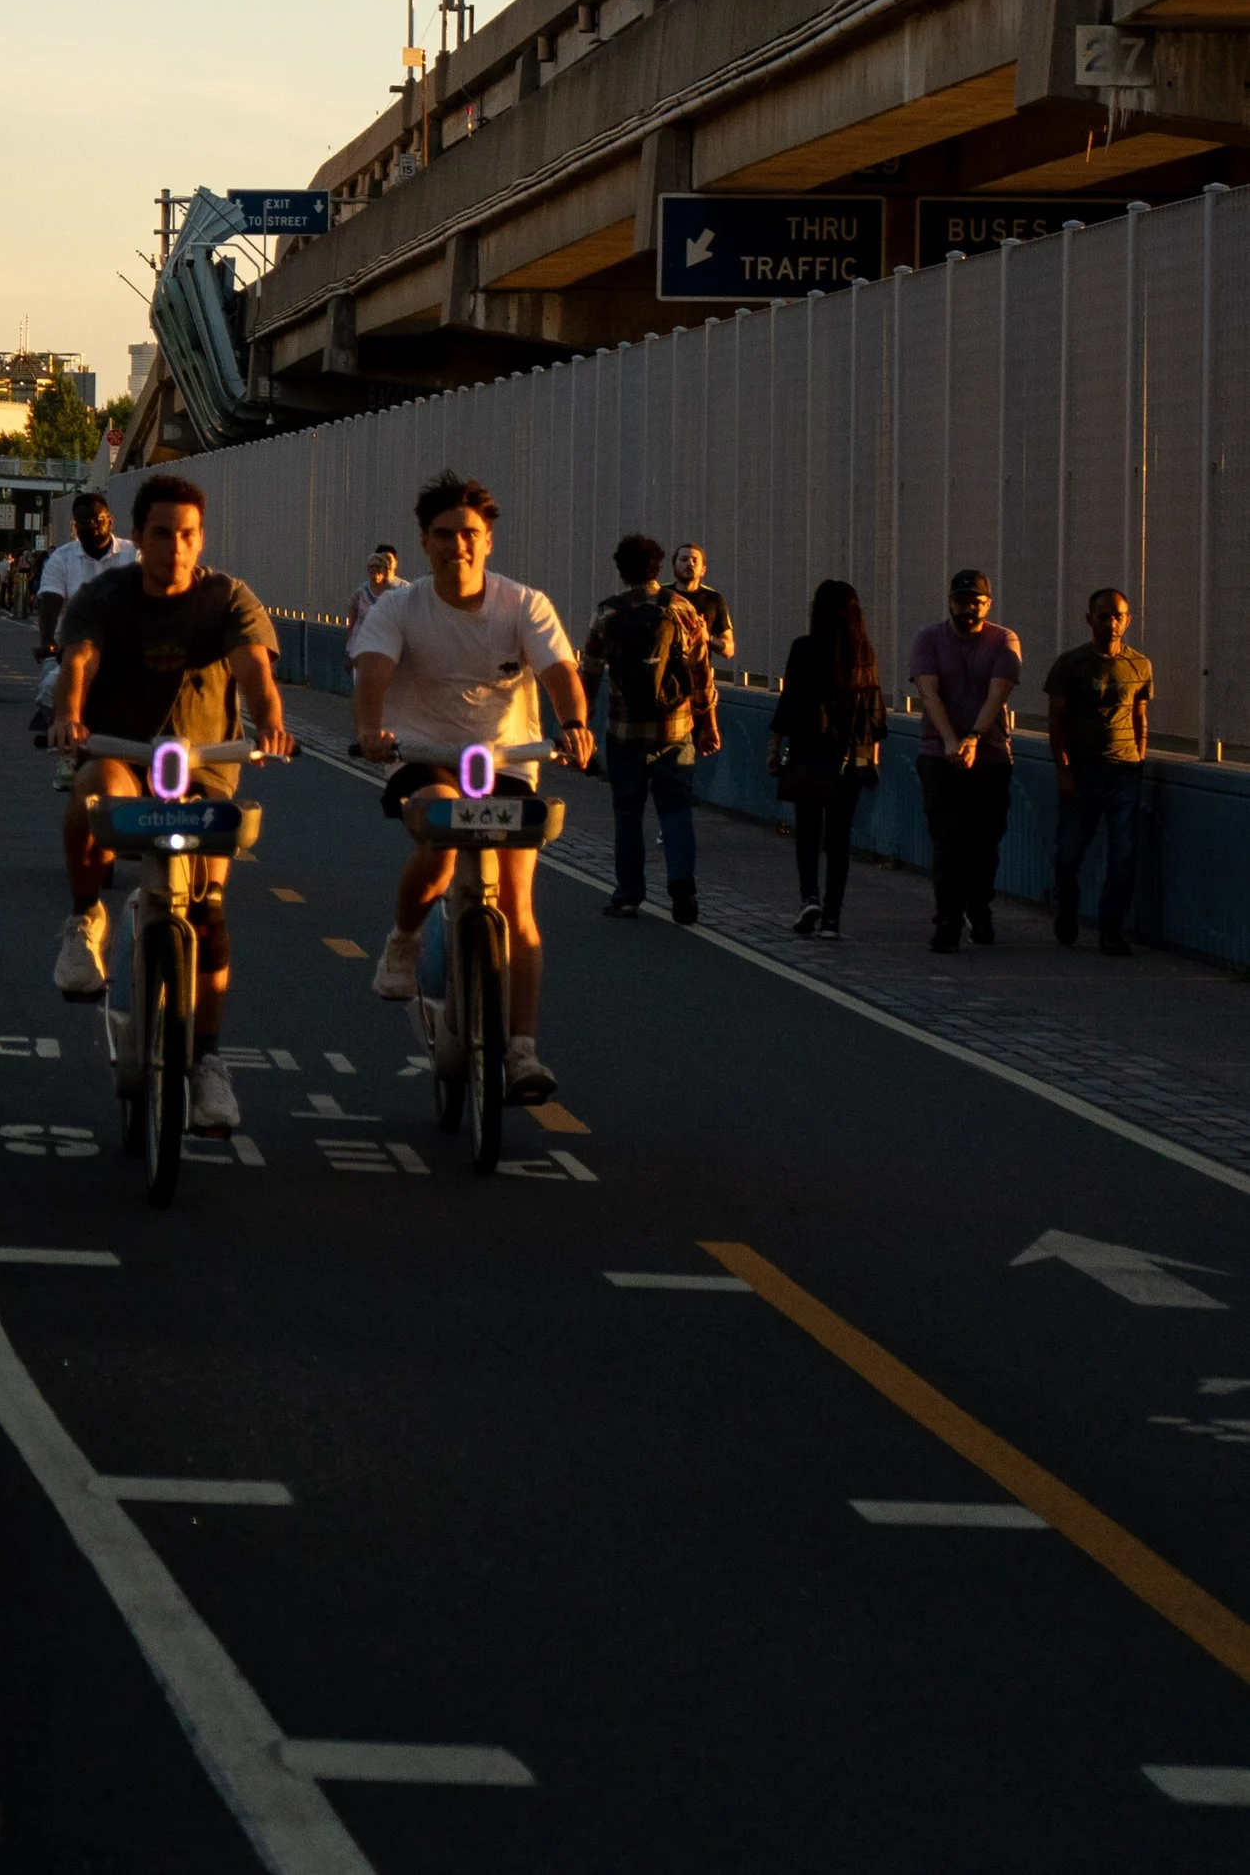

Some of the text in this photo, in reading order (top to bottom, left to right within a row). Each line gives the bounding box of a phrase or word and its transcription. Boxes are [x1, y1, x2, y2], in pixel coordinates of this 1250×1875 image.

[1085, 36, 1146, 74] 27
[403, 166, 413, 175] 15
[265, 198, 291, 210] EXIT
[248, 216, 308, 227] TO STREET
[786, 216, 859, 242] THRU
[947, 218, 1048, 242] BUSES
[740, 256, 859, 282] TRAFFIC
[138, 810, 200, 826] citi bike
